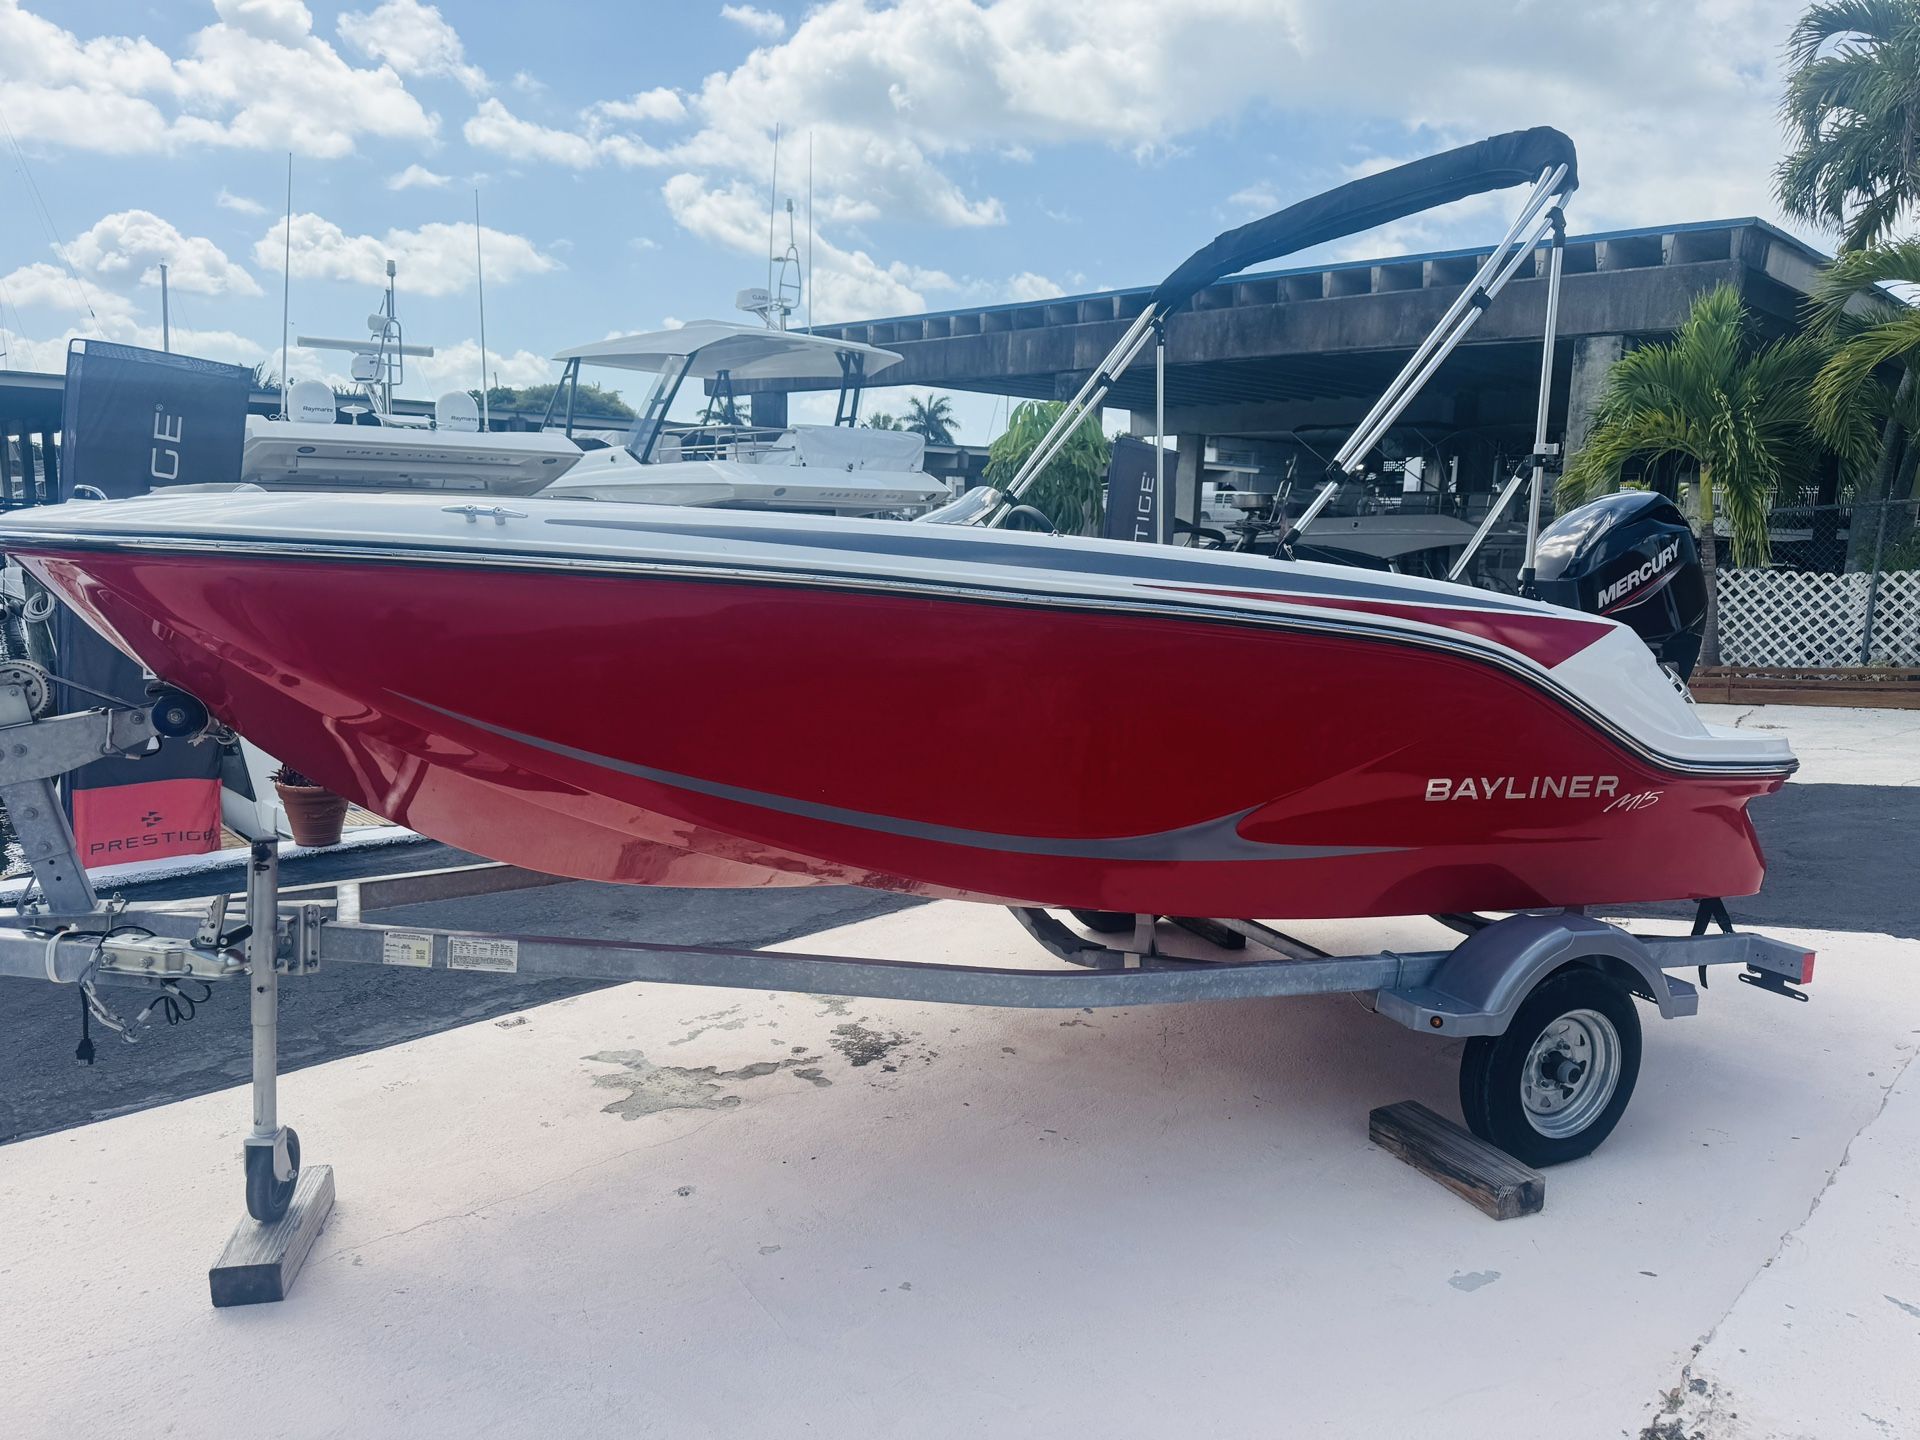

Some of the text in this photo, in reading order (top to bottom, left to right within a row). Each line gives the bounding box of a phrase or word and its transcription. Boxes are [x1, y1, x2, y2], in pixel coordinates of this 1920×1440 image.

[1598, 538, 1680, 608] MERCURY
[1425, 775, 1620, 801] BAYLINER
[1603, 791, 1665, 813] M15
[91, 831, 216, 856] PRESTIGE
